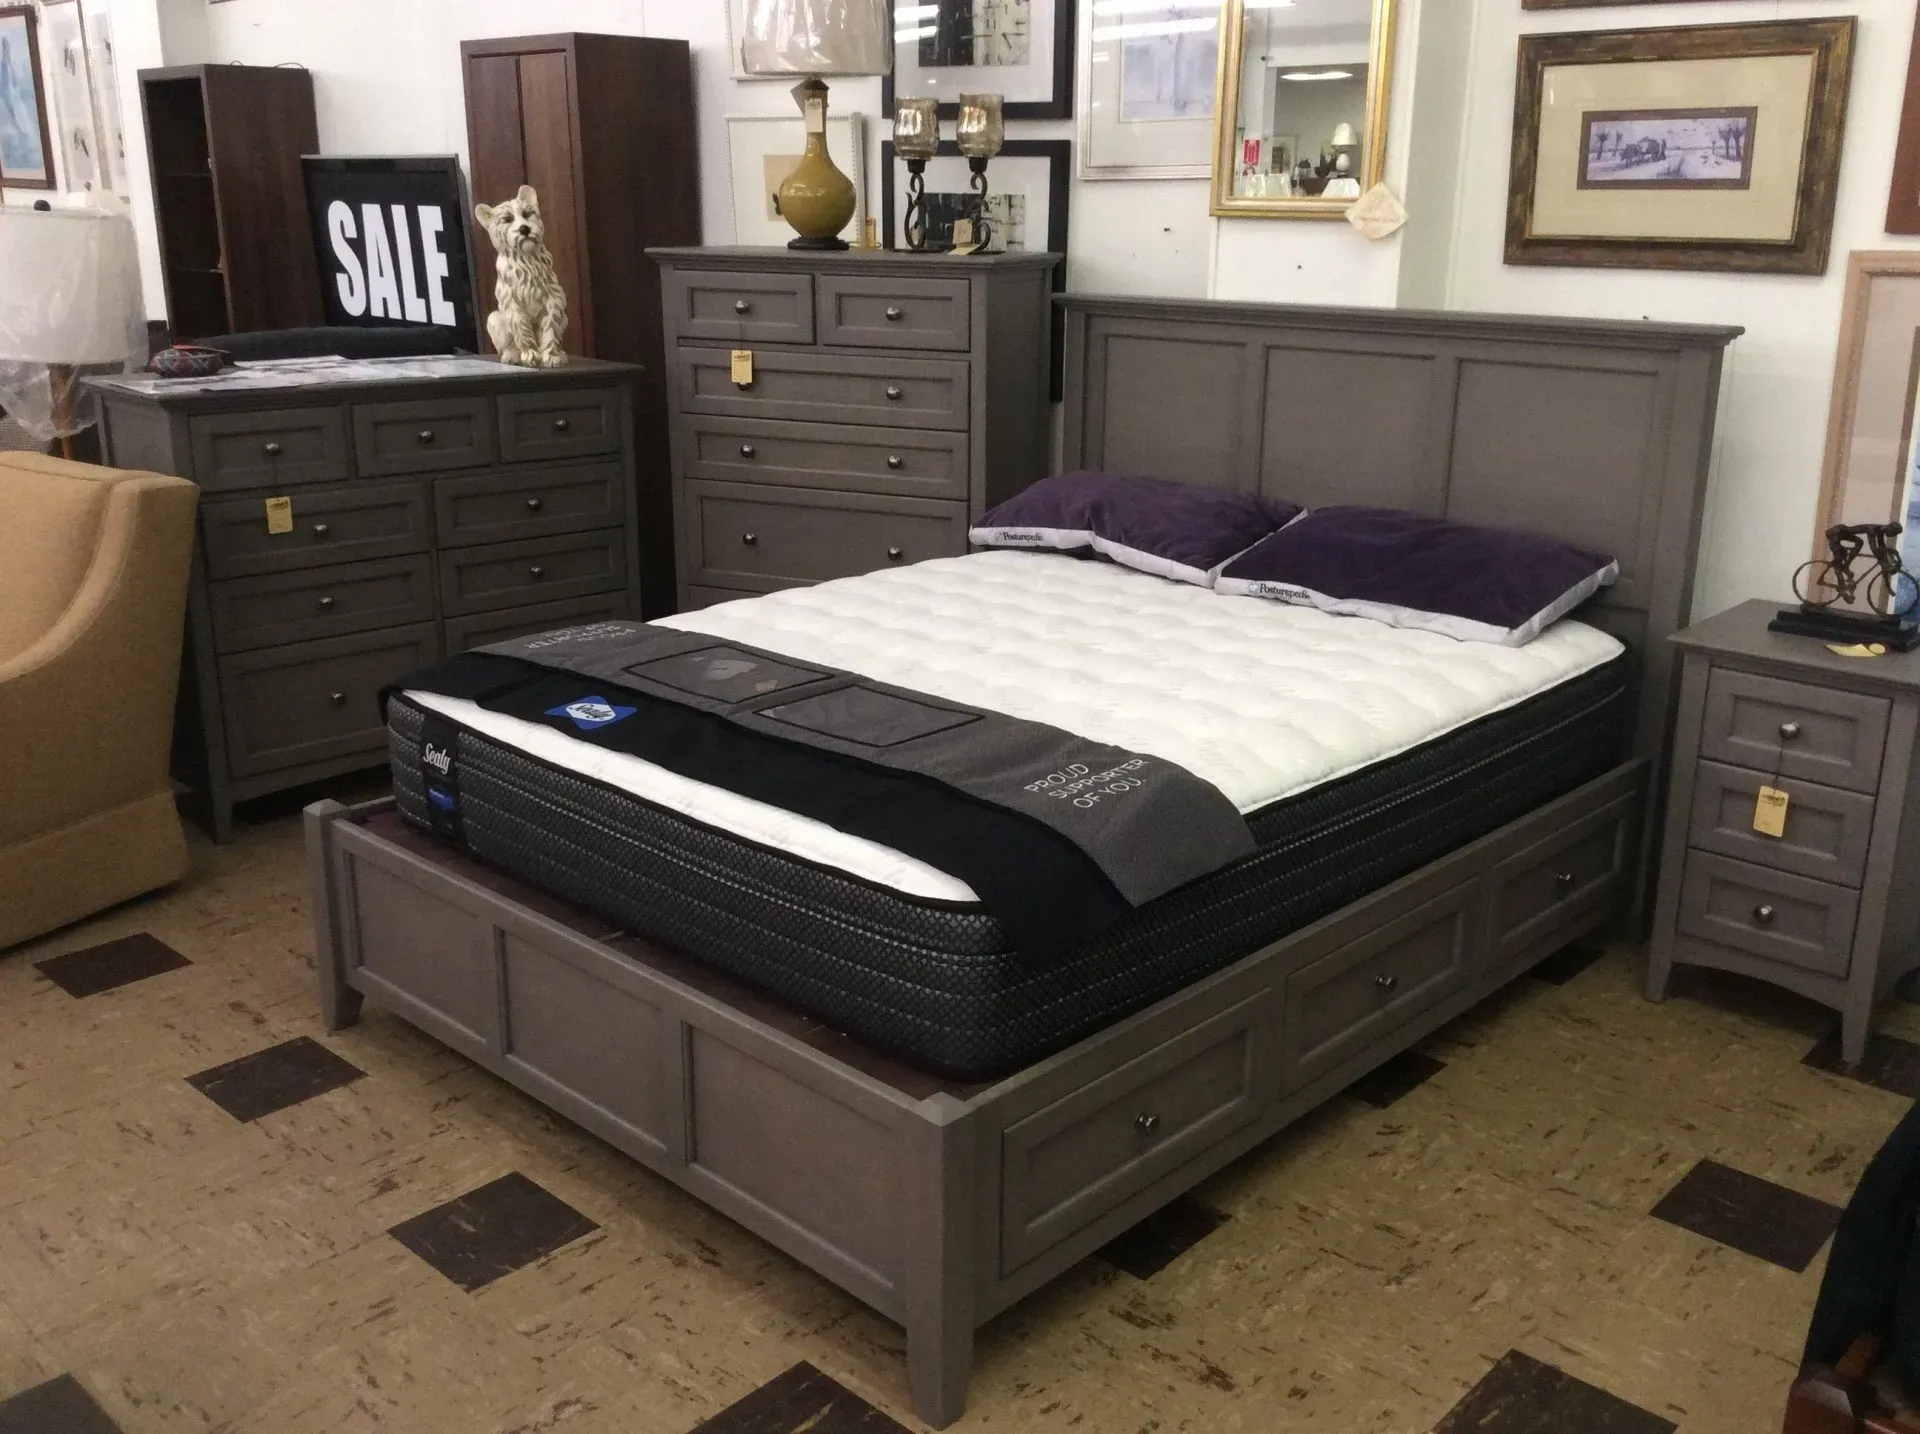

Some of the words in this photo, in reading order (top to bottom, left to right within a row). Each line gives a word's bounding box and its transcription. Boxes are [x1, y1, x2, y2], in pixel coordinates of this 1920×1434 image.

[328, 200, 456, 327] SALE
[423, 743, 451, 775] Sealy
[1024, 763, 1089, 793] PROUD
[1048, 758, 1150, 799] SUPPORTER
[1073, 792, 1101, 808] OF
